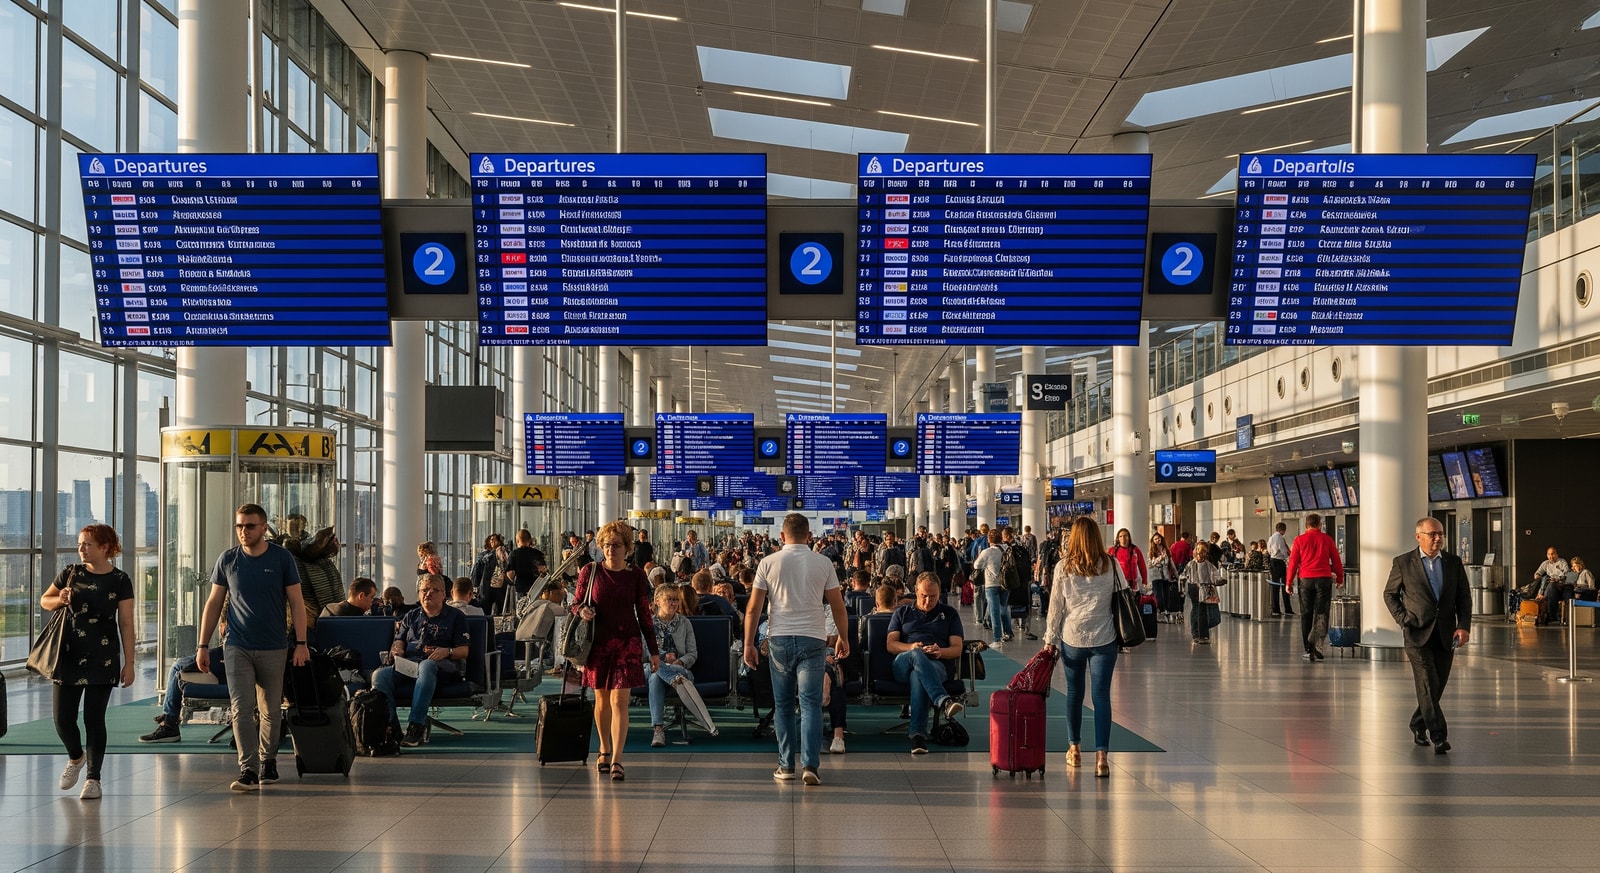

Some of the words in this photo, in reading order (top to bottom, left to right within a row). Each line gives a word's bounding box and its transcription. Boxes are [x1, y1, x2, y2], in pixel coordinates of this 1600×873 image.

[114, 158, 207, 176] Departures
[504, 158, 596, 176] Departures
[892, 158, 985, 176] Departures
[424, 246, 445, 276] 2
[801, 246, 822, 275] 2
[1171, 246, 1193, 276] 2
[1031, 383, 1044, 400] 3
